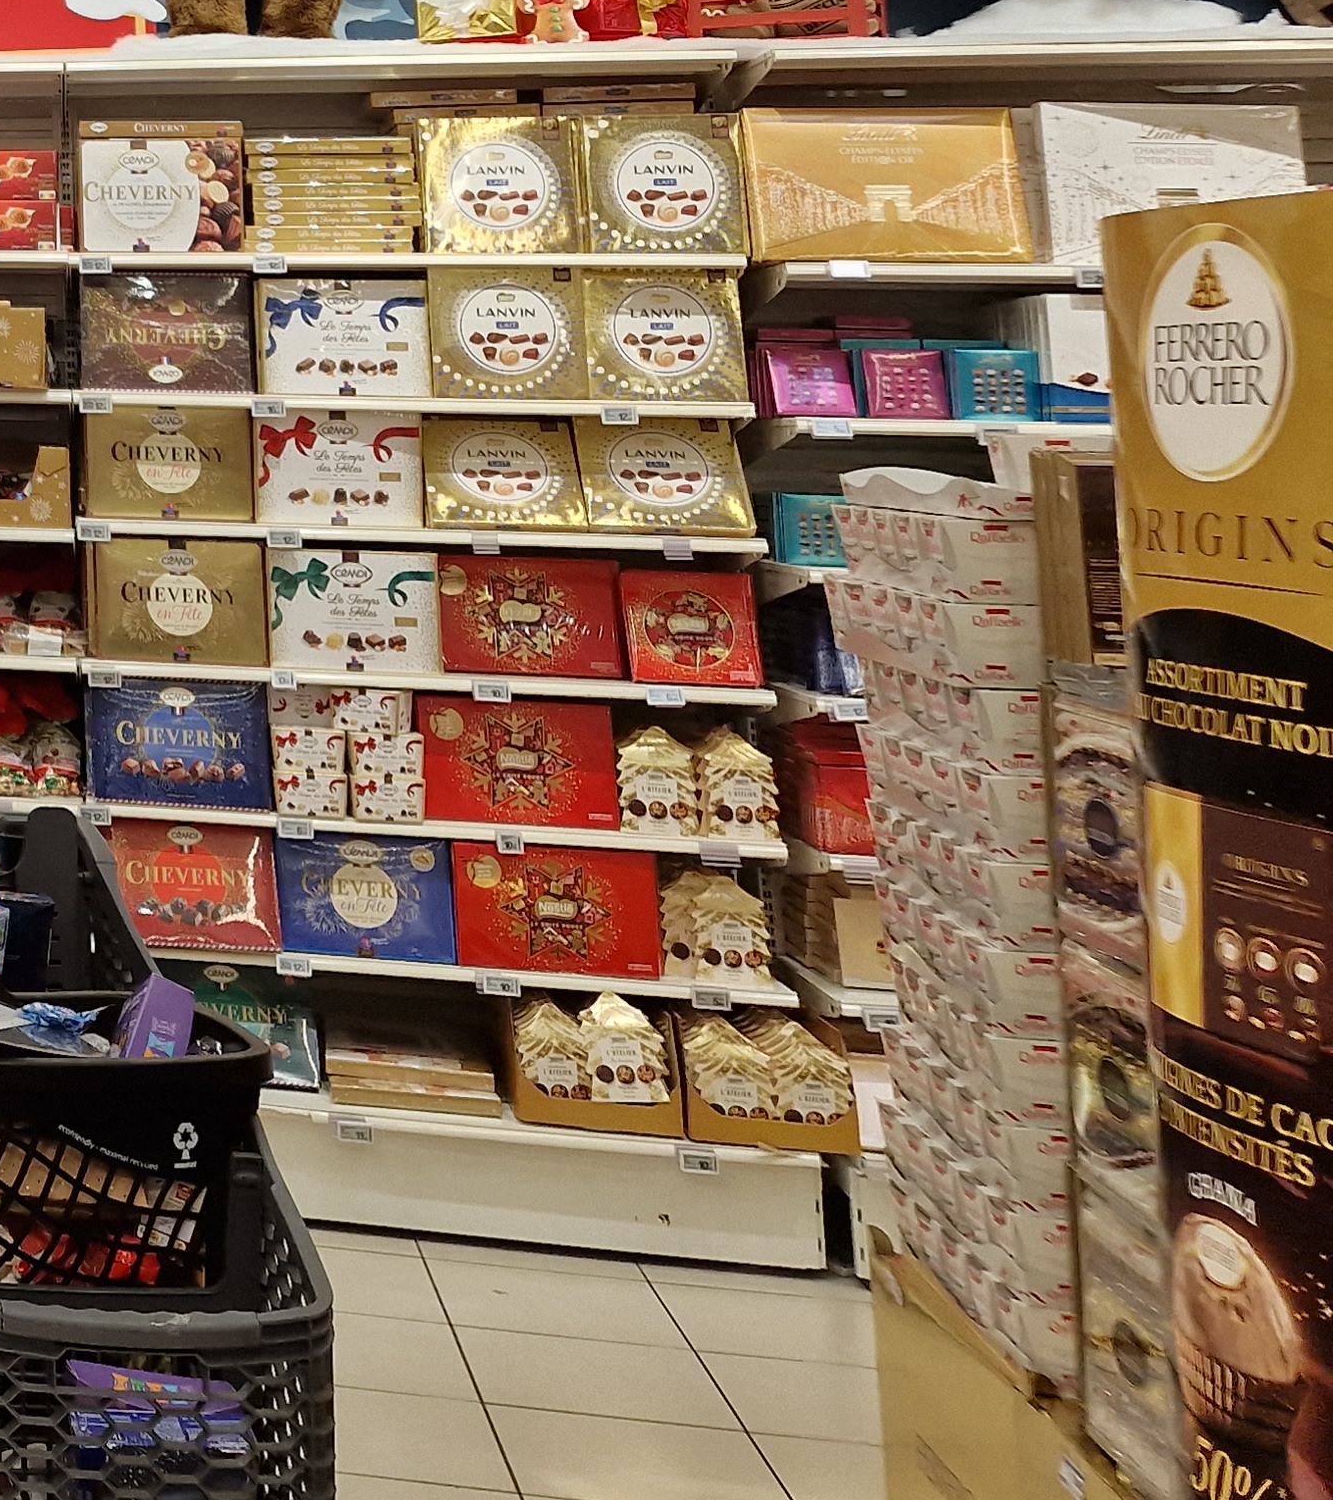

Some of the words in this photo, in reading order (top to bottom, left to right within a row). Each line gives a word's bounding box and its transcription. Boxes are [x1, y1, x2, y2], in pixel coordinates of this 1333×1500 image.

[134, 123, 187, 133] CHEVERNY
[467, 165, 524, 176] LANVIN
[634, 164, 694, 175] LANVIN
[84, 181, 197, 203] CHEVERNY
[477, 308, 535, 318] LANVIN
[631, 309, 690, 318] LANVIN
[340, 320, 371, 333] Temps
[107, 325, 226, 350] CHEVERNY
[323, 333, 337, 343] des
[1154, 319, 1271, 365] FERRERO
[1154, 365, 1271, 407] ROCHER
[111, 441, 223, 462] CHEVERNY
[332, 451, 366, 463] Temps
[468, 450, 525, 459] LANVIN
[625, 450, 685, 459] LANVIN
[316, 464, 330, 472] des
[970, 531, 1025, 543] Raffaello
[121, 581, 234, 605] CHEVERNY
[347, 594, 379, 607] Temps
[330, 607, 345, 617] des
[972, 615, 1025, 628] Raffaello
[1146, 659, 1307, 711] ASSORTIMENT
[1152, 696, 1266, 745] CHOCOLAT
[116, 721, 242, 749] CHEVERNY
[125, 861, 250, 887] CHEVERNY
[302, 873, 421, 900] CHEVERNY
[204, 1003, 287, 1024] VERNY
[1225, 1085, 1266, 1127] DE
[58, 1123, 95, 1150] ecofriendly
[99, 1145, 130, 1163] maximal
